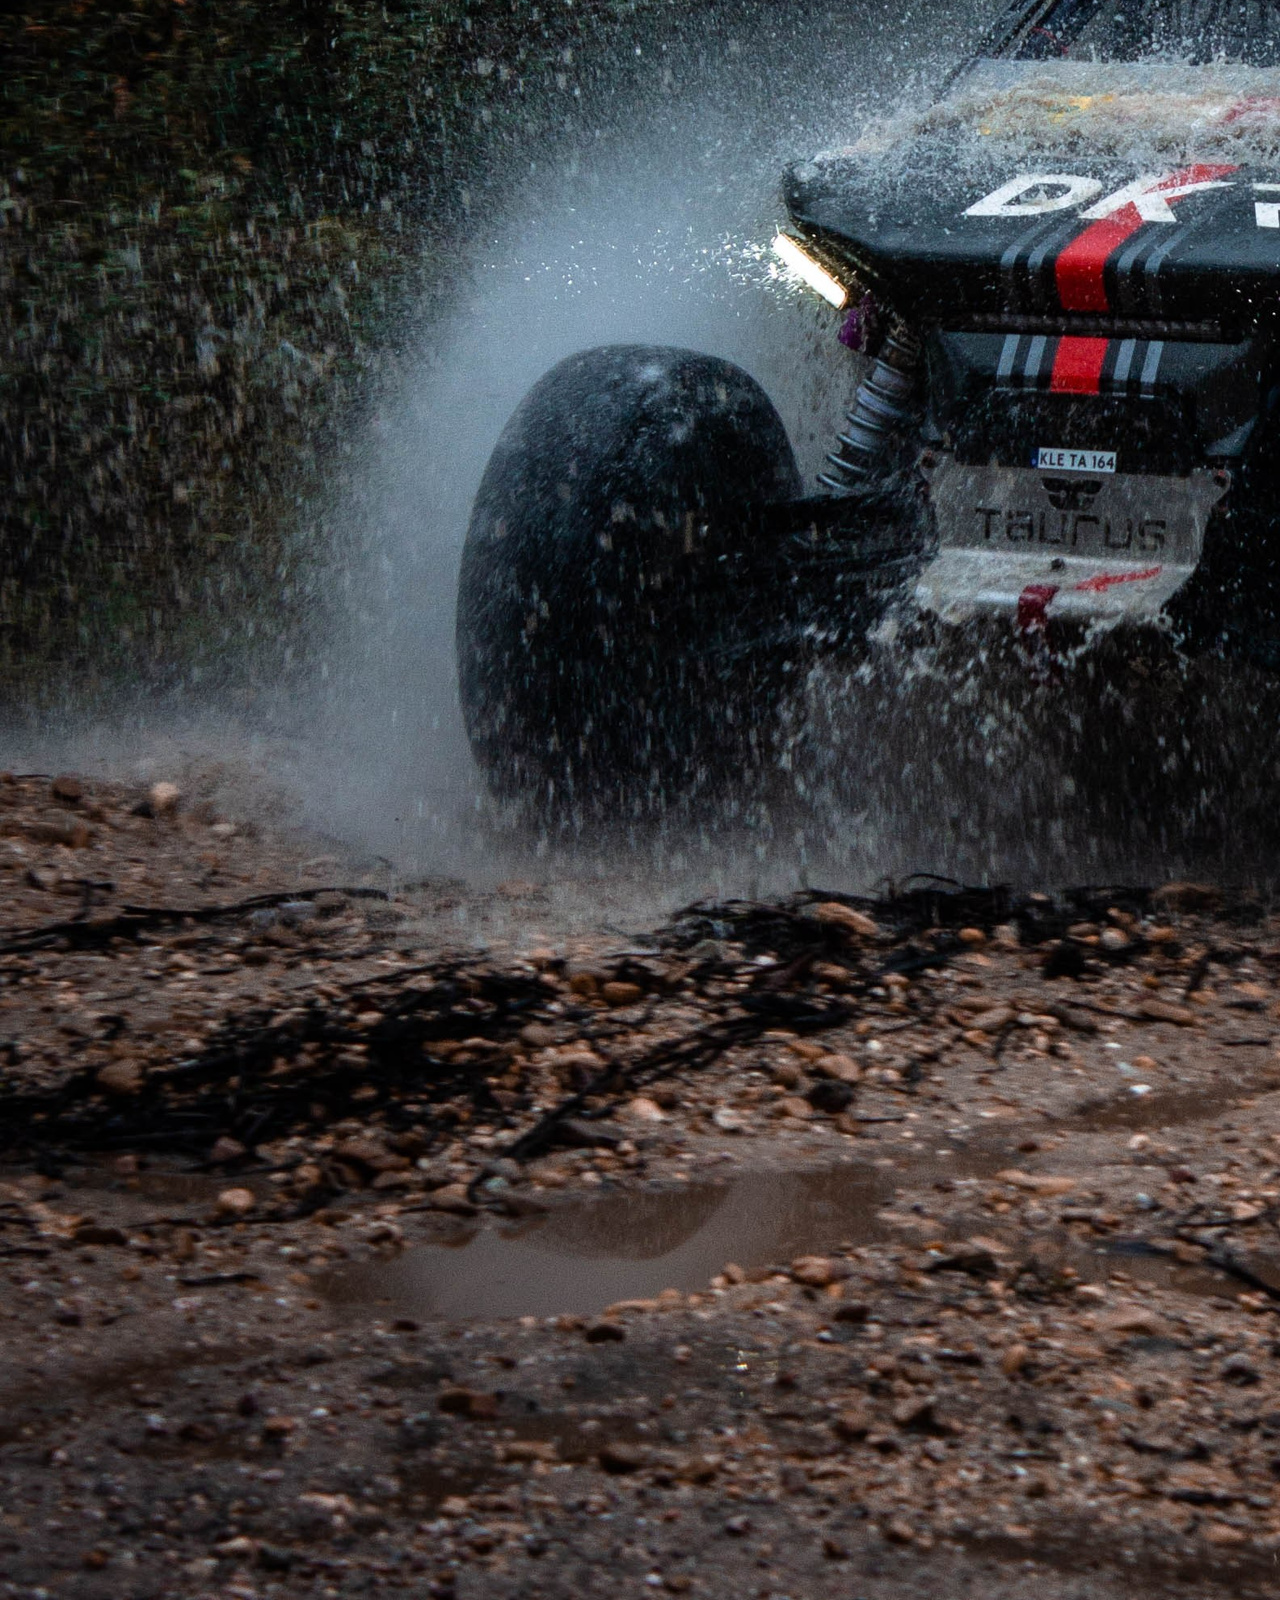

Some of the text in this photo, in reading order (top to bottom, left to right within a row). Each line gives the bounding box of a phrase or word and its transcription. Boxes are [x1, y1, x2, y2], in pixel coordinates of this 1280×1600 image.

[1038, 451, 1116, 470] KLE TA 164
